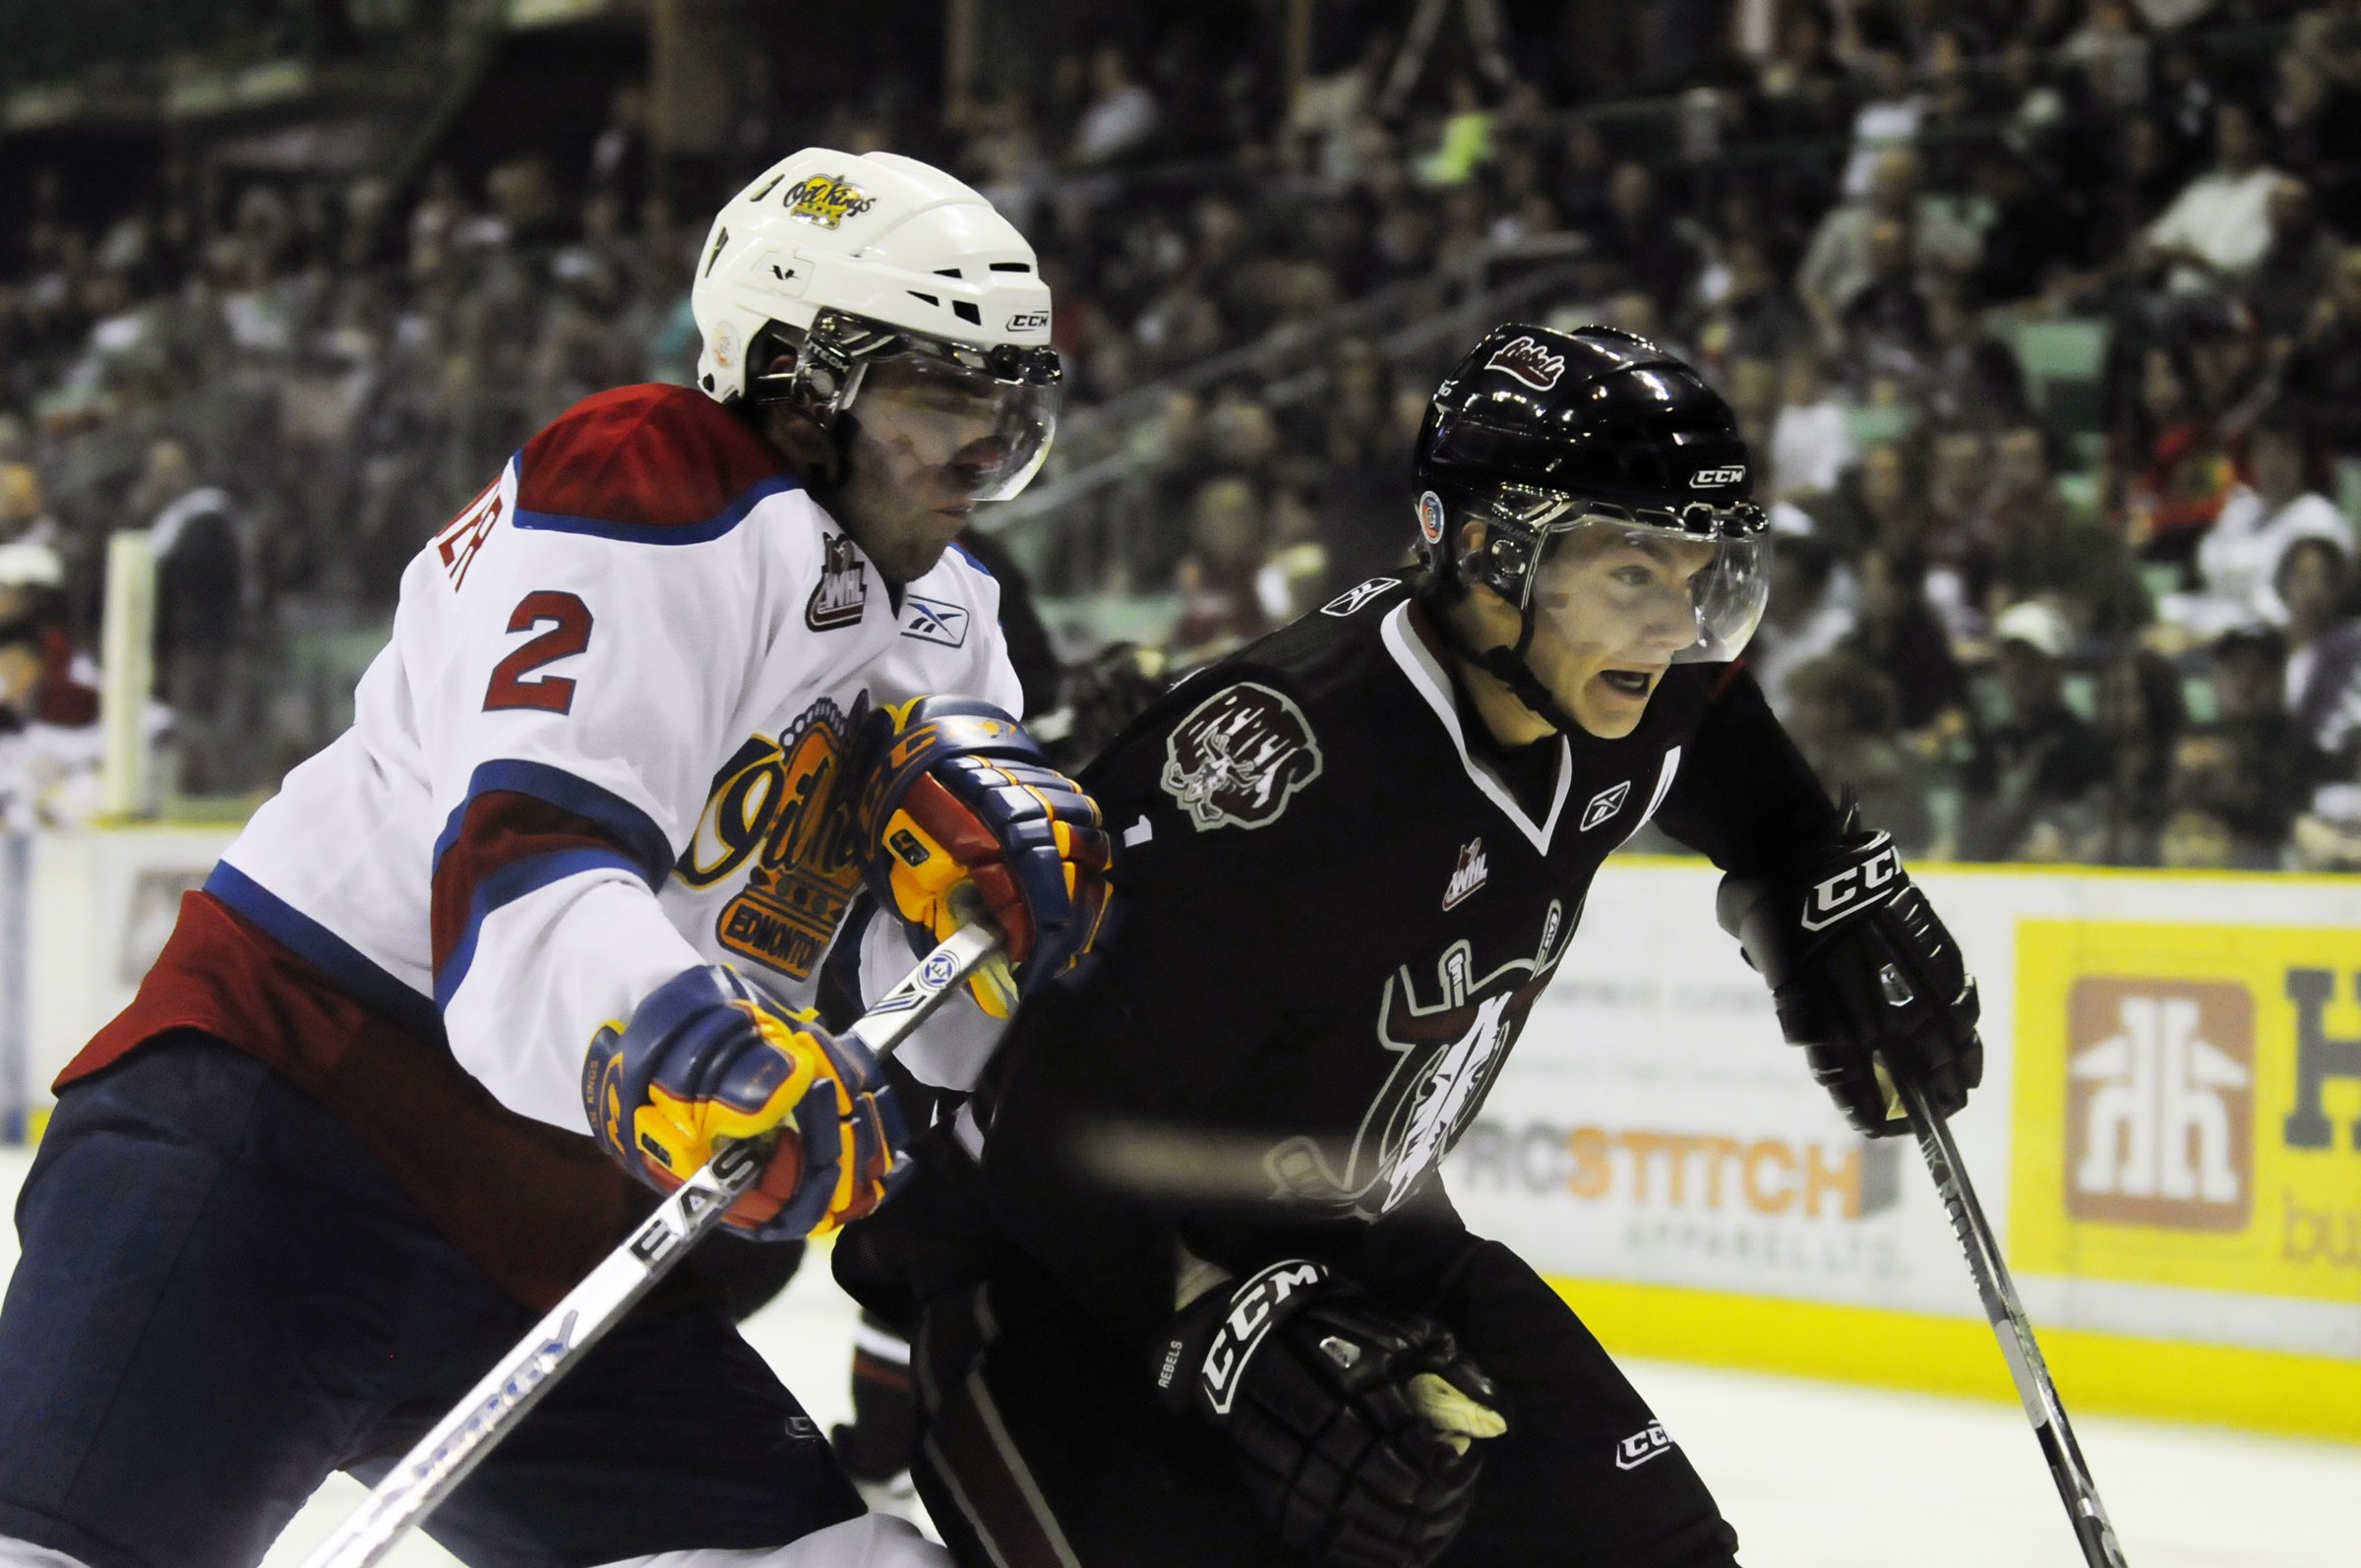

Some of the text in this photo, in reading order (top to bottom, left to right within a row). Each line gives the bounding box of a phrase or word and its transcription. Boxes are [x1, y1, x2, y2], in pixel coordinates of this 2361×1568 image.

[1012, 315, 1049, 328] CCM
[1697, 469, 1743, 483] CCM
[482, 590, 594, 716] 2
[1202, 1264, 1319, 1390] CCM
[1158, 1340, 1183, 1388] REBELS
